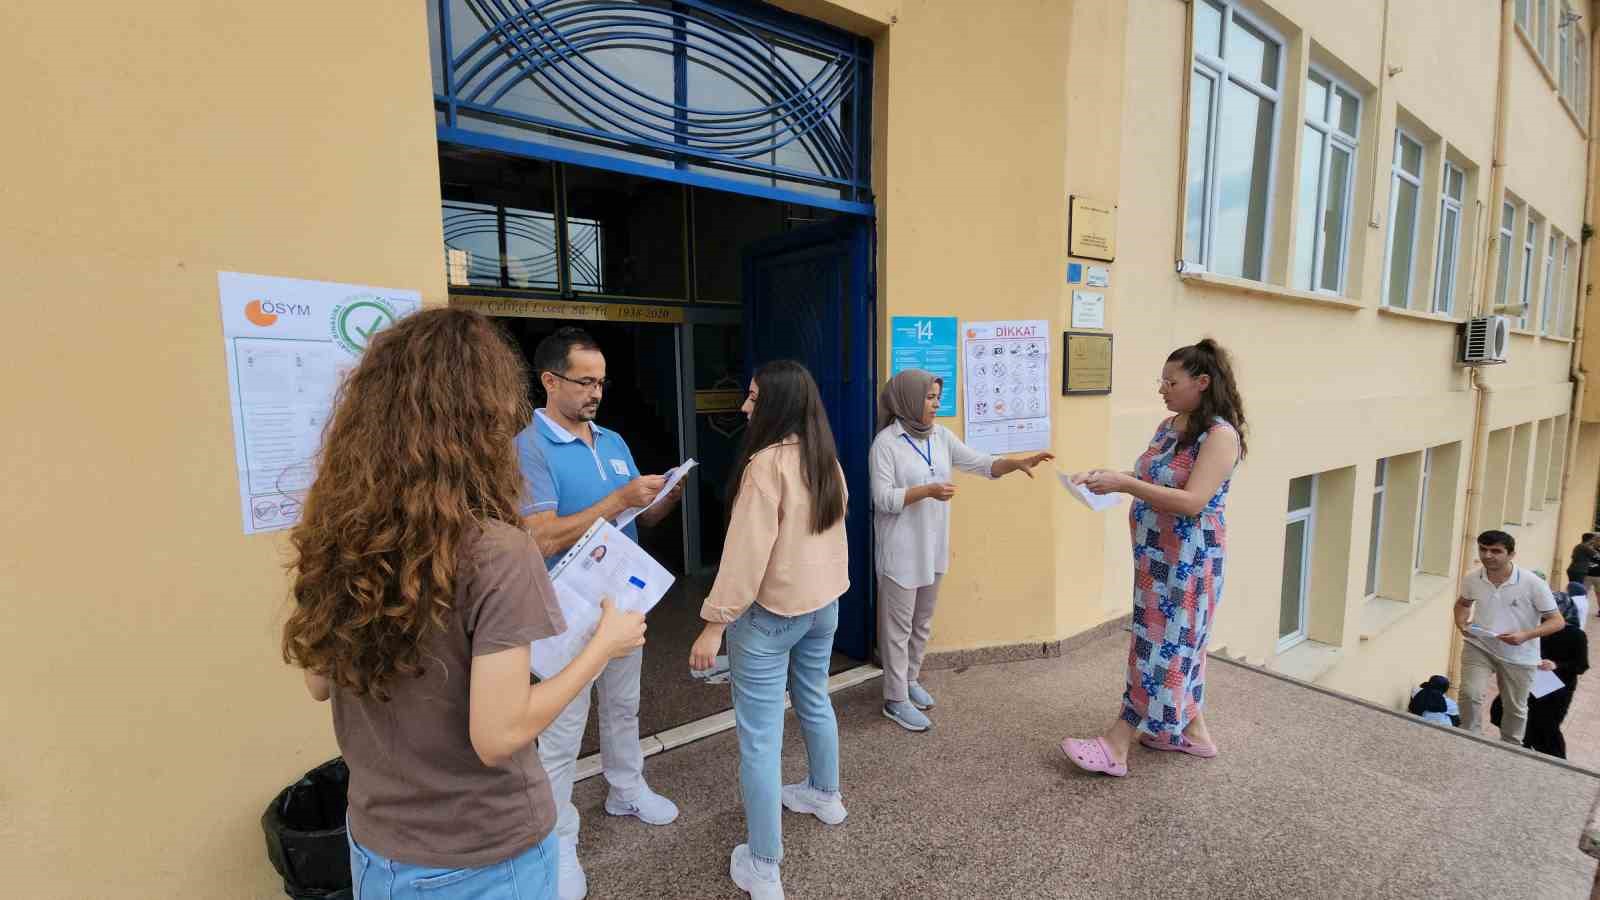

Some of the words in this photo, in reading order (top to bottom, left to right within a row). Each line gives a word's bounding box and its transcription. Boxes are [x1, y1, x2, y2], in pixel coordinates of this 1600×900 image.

[262, 298, 311, 316] ÖSYM
[914, 320, 934, 340] 14
[996, 325, 1037, 337] DİKKAT
